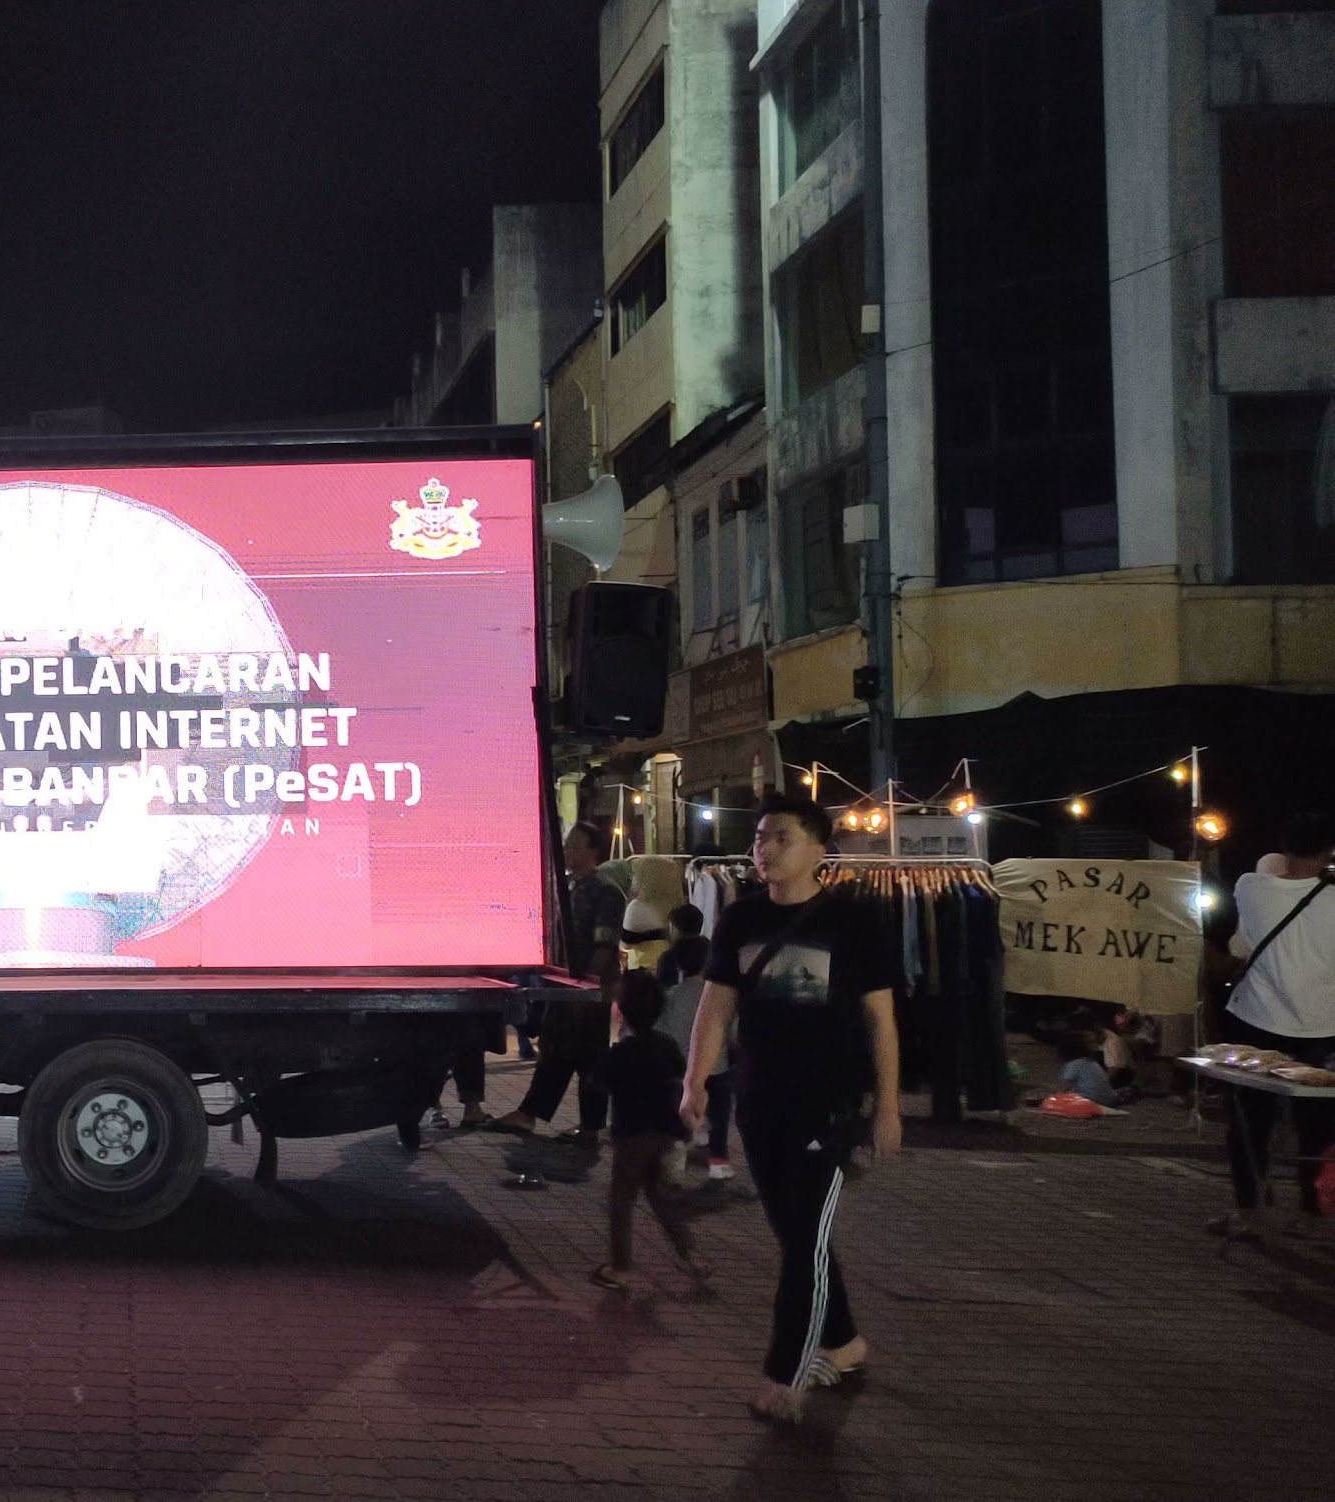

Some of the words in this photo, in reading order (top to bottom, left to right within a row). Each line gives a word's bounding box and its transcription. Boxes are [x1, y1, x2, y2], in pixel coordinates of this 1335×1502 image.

[0, 652, 332, 697] PELANCARAN
[118, 706, 358, 751] INTERNET
[222, 761, 422, 807] (PeSAT)
[1028, 866, 1152, 910] PASAR
[1013, 921, 1087, 956] MEK
[1097, 927, 1178, 964] AWE
